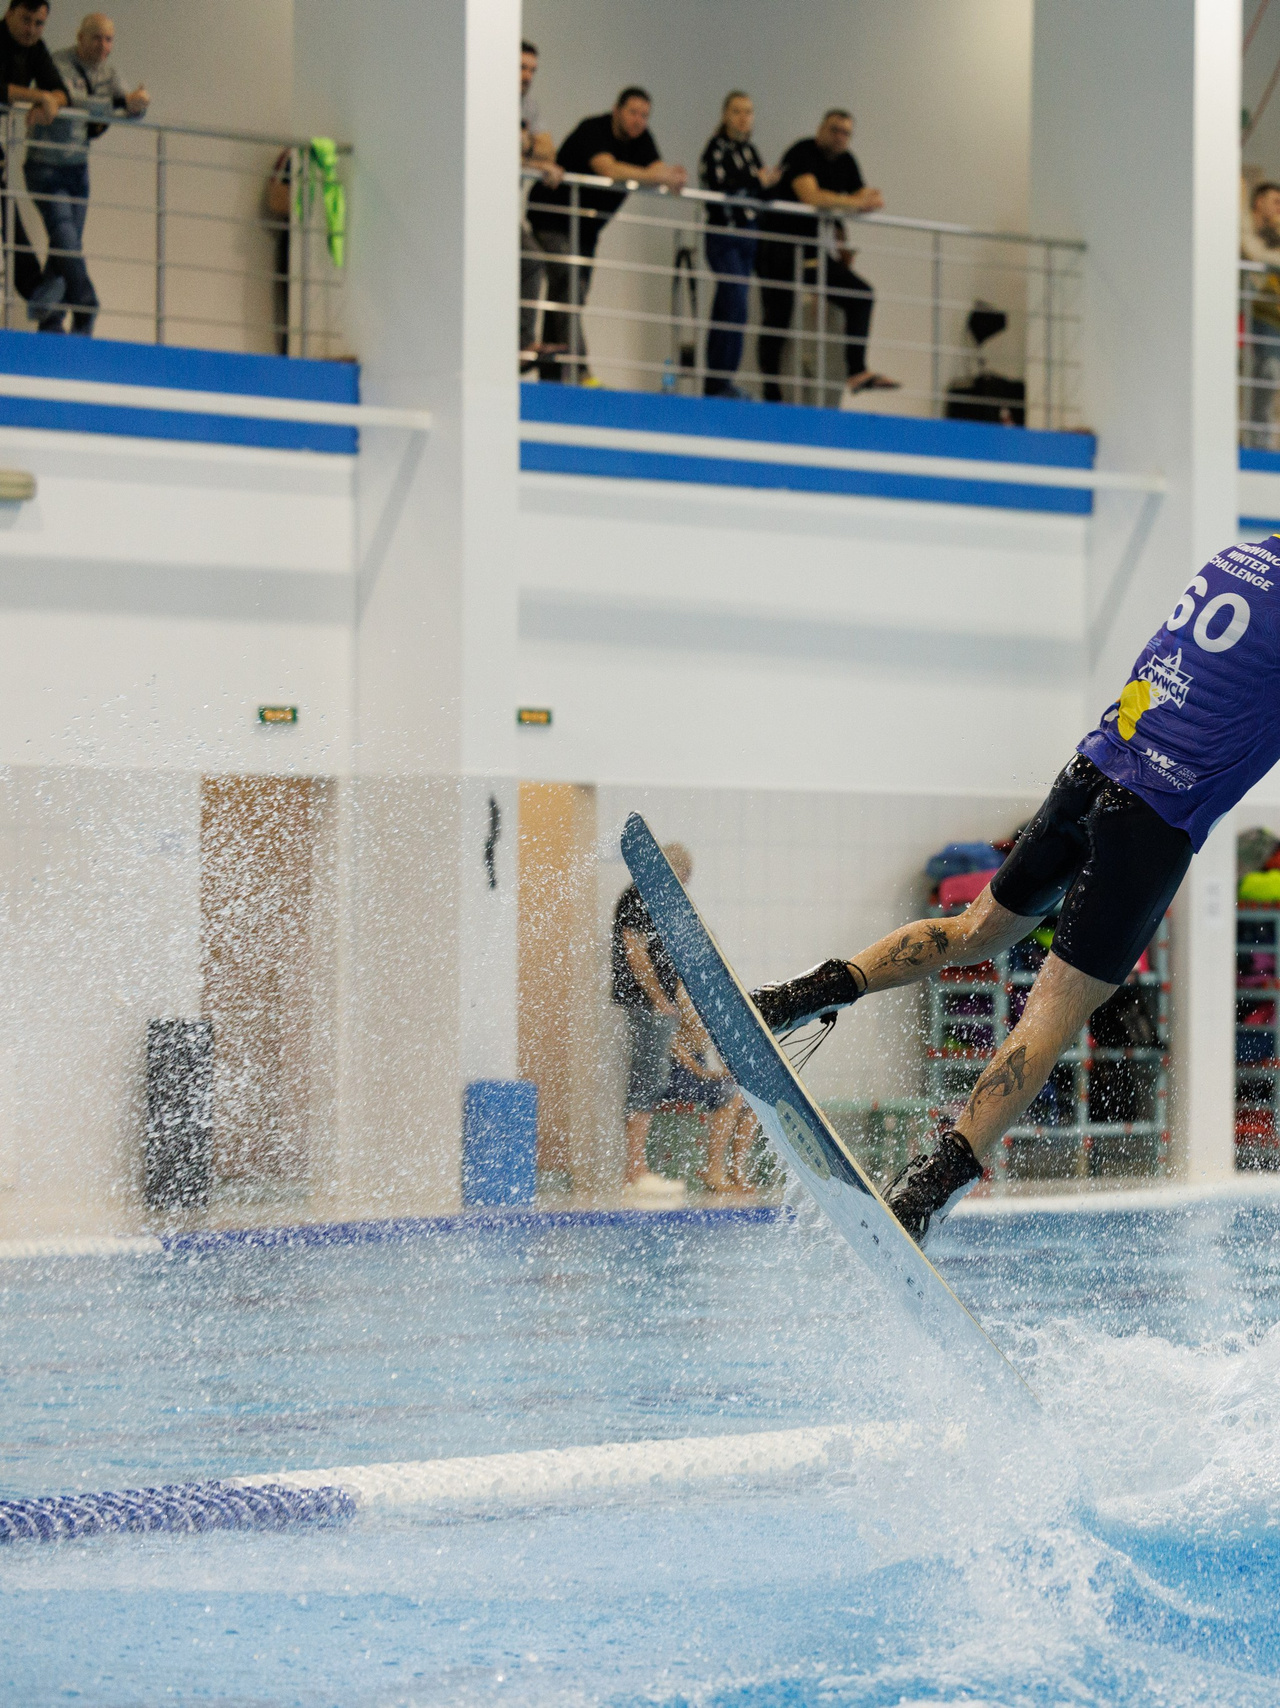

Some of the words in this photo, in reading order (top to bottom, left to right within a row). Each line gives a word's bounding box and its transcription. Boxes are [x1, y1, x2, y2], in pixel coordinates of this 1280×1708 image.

[1209, 554, 1275, 592] CHALLENGE
[1226, 550, 1271, 575] WINTER
[1166, 575, 1251, 653] 60
